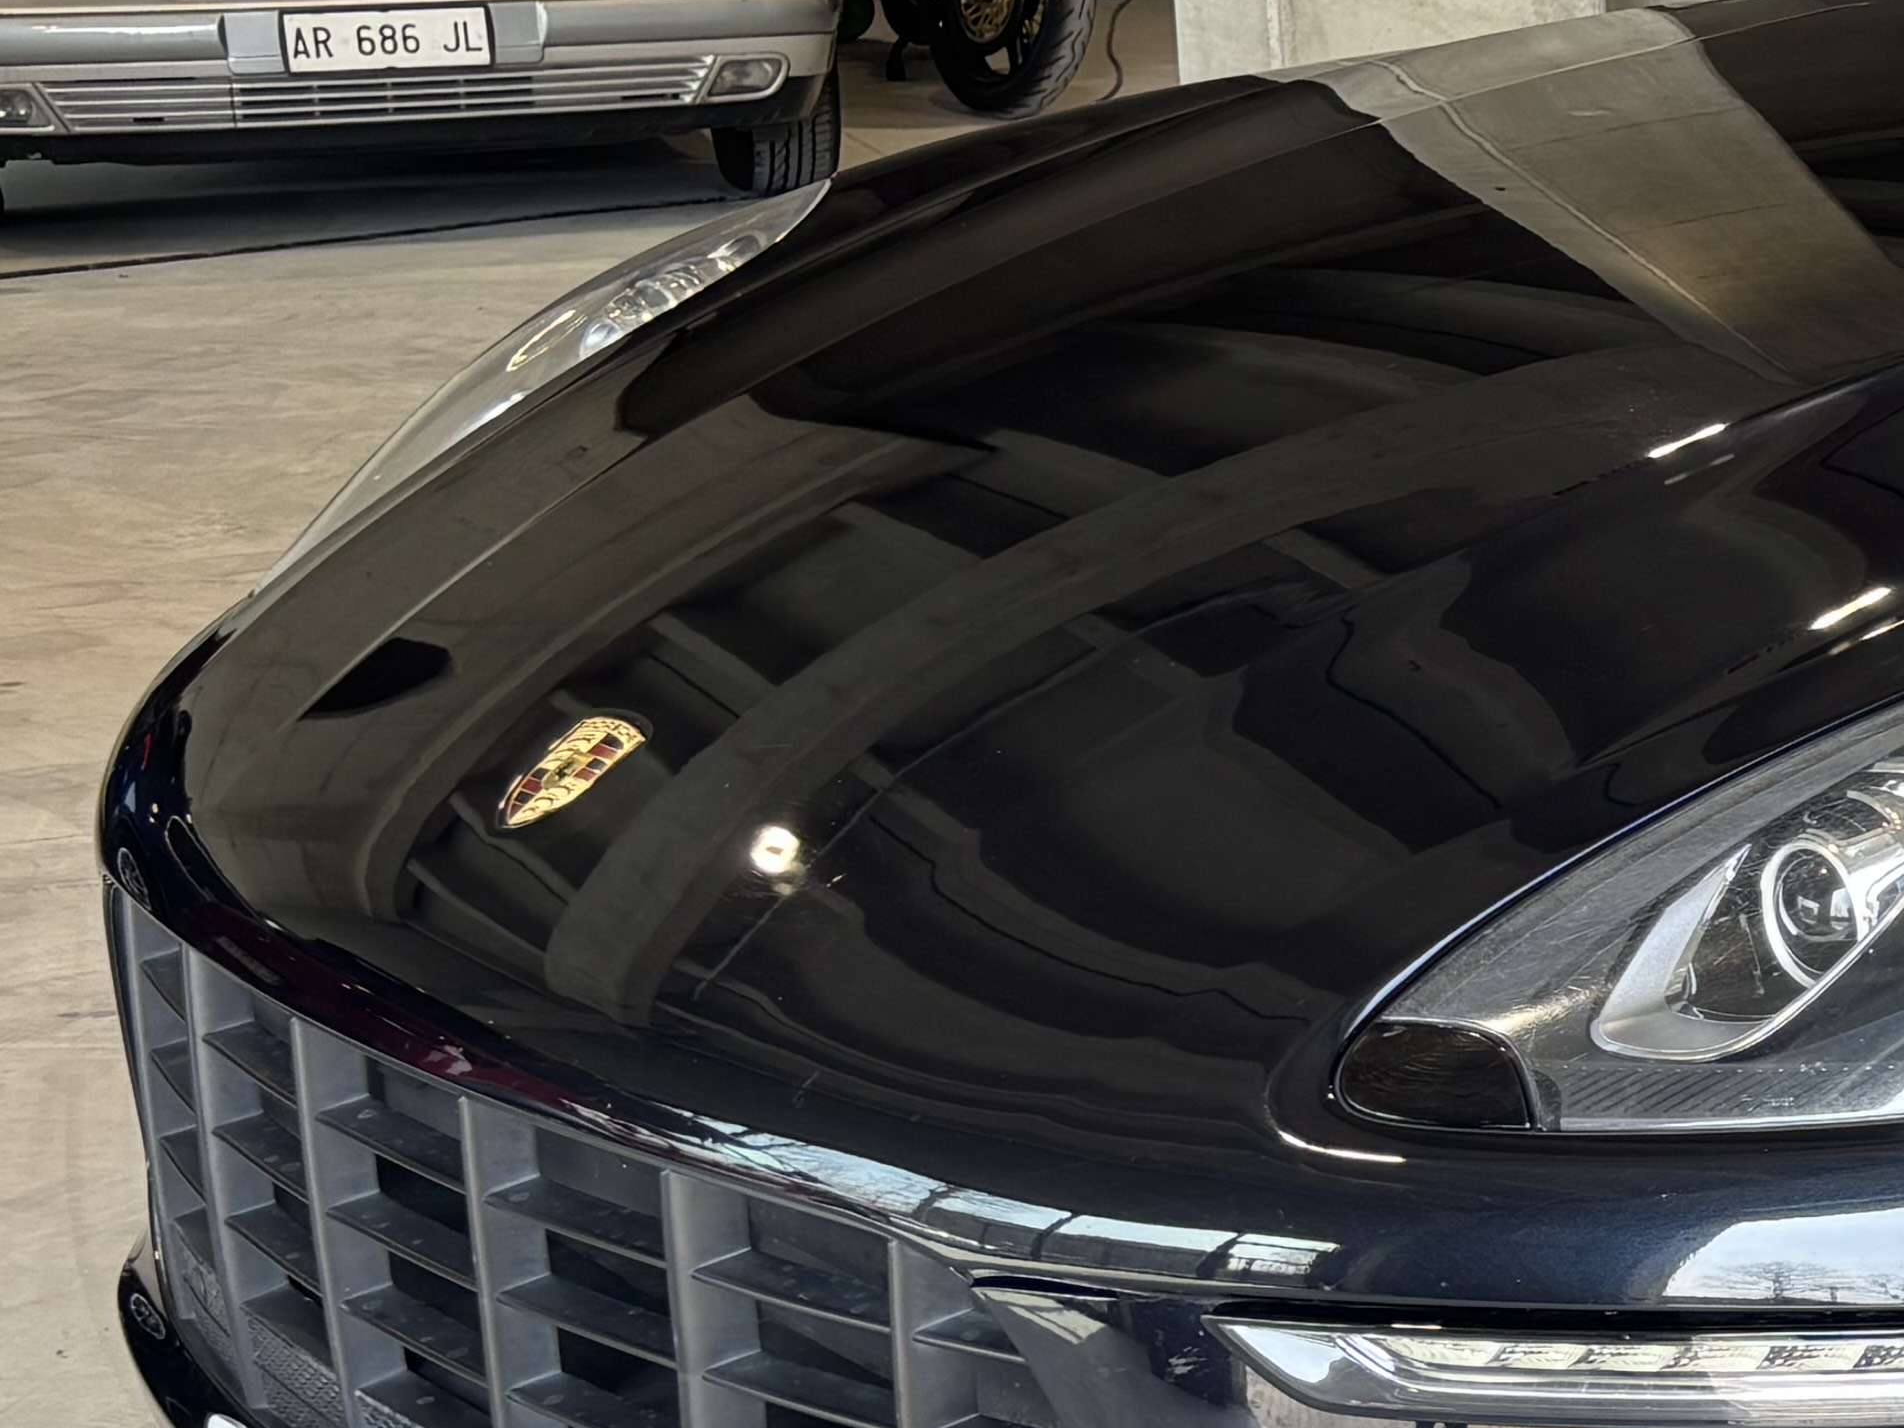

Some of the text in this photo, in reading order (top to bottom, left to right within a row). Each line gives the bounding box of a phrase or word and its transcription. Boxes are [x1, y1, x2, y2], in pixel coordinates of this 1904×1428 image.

[293, 20, 484, 60] AR 686 JL
